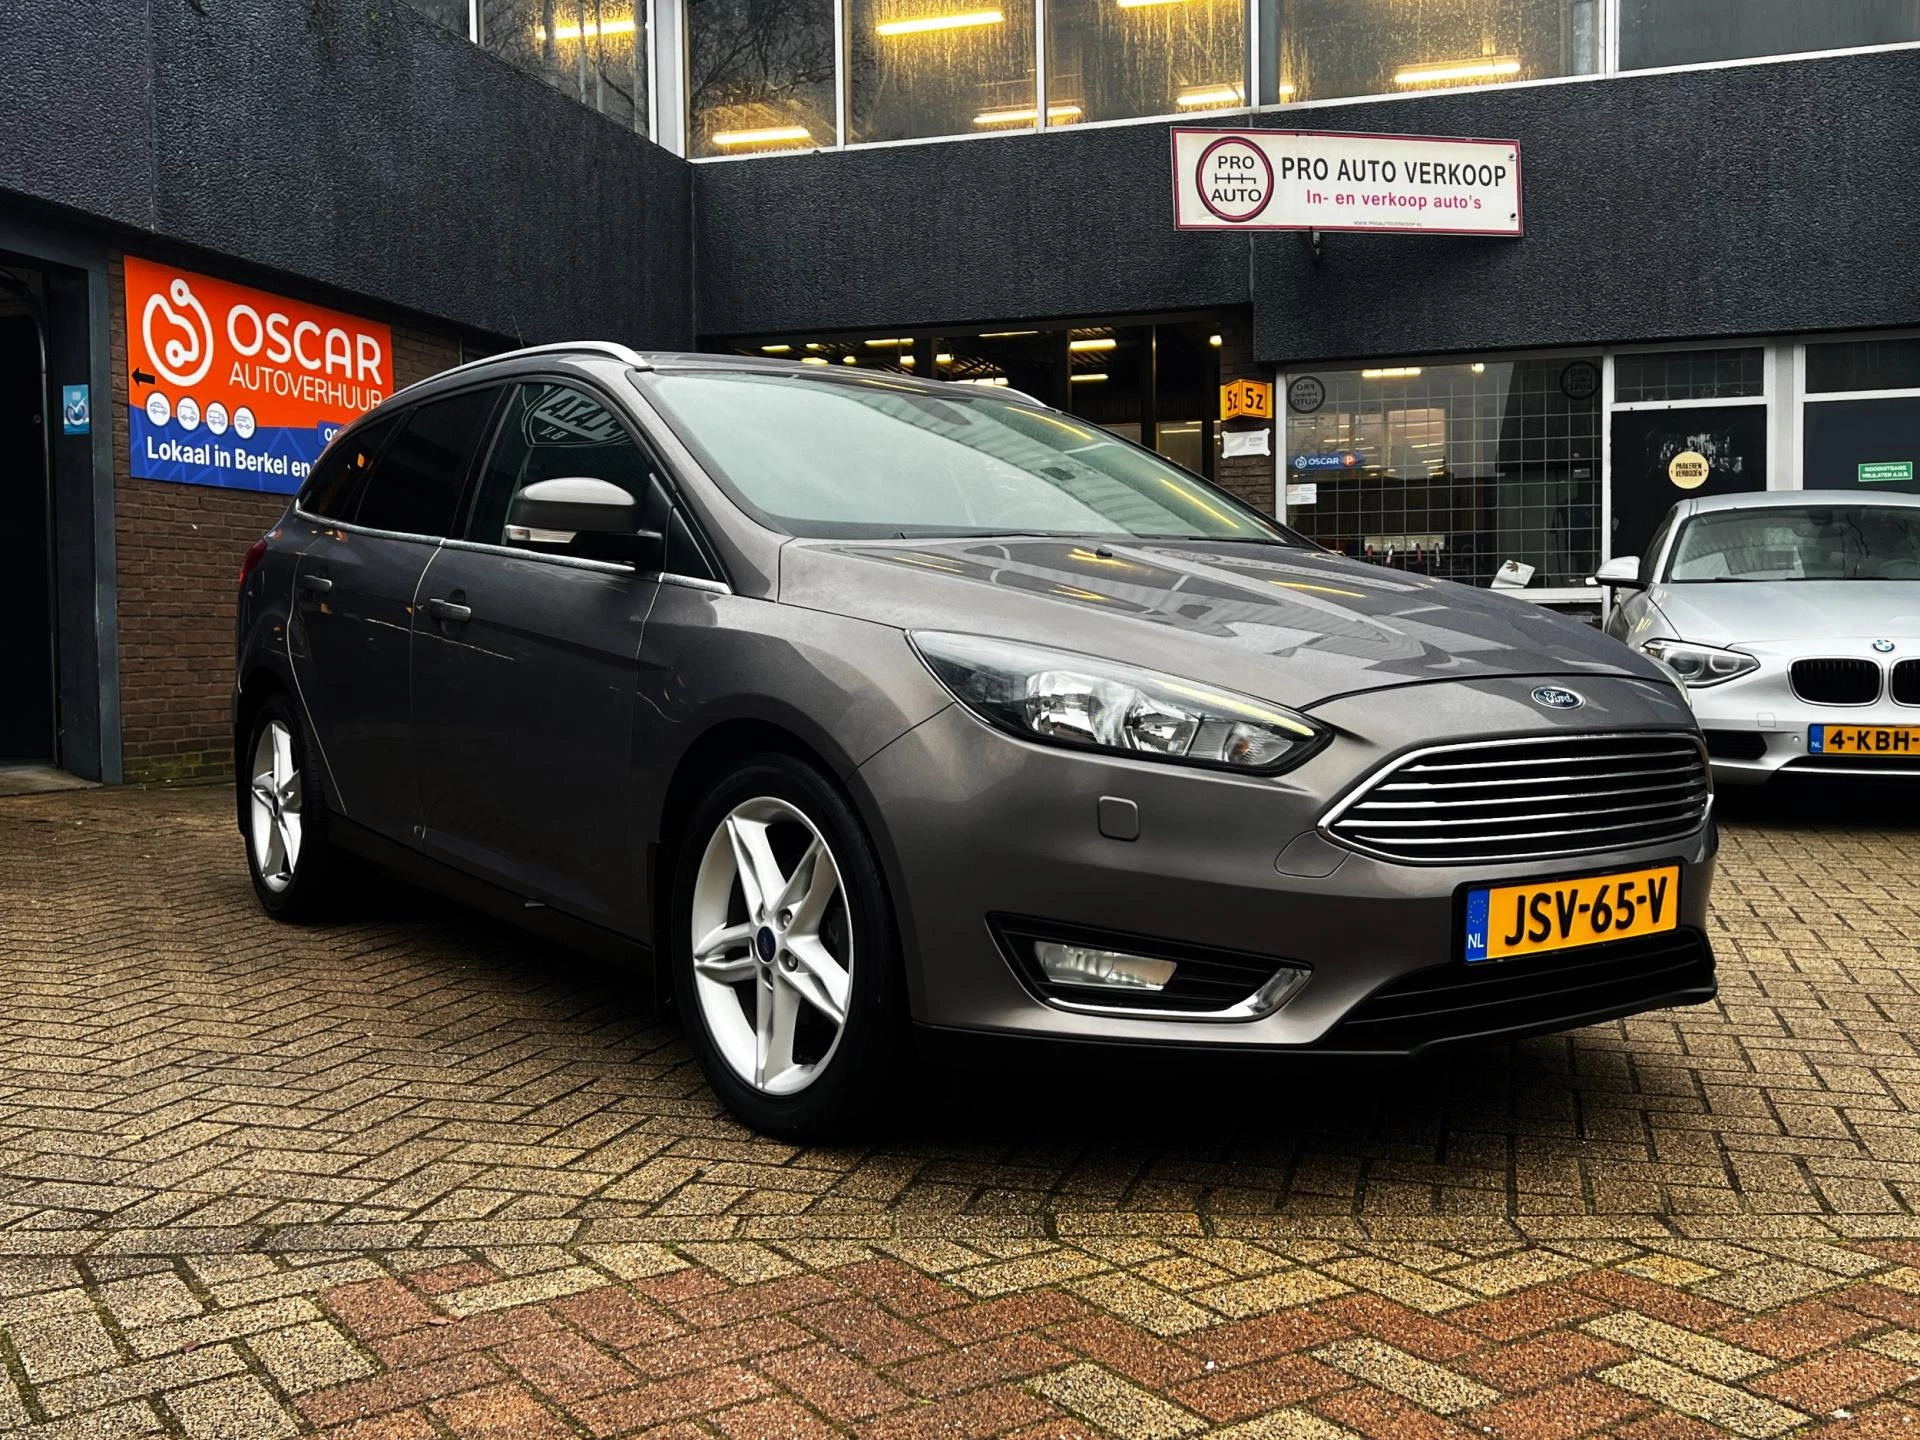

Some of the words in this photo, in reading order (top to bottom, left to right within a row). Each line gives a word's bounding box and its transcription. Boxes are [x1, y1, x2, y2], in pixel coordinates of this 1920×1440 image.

[1217, 155, 1255, 170] PRO
[1281, 156, 1329, 182] PRO
[1337, 159, 1397, 184] AUTO
[1404, 161, 1507, 188] VERKOOP
[1210, 188, 1263, 203] AUTO
[1306, 189, 1330, 205] In-
[1335, 193, 1356, 206] en
[1361, 193, 1428, 211] verkoop
[1433, 195, 1483, 210] auto's
[227, 304, 382, 385] OSCAR
[229, 361, 382, 411] AUTOVERHUUR
[1245, 388, 1264, 411] 5z
[146, 435, 210, 466] Lokaal
[214, 445, 230, 468] in
[235, 448, 288, 475] Berkel
[291, 460, 311, 478] en
[1308, 457, 1339, 466] OSCAR
[1675, 462, 1703, 470] PARKEREN
[1675, 469, 1703, 478] VERBODEN
[1543, 690, 1574, 704] Ford
[1829, 729, 1920, 751] 4-KBH-
[1504, 876, 1668, 946] JSV-65-V
[1467, 932, 1485, 950] NL
